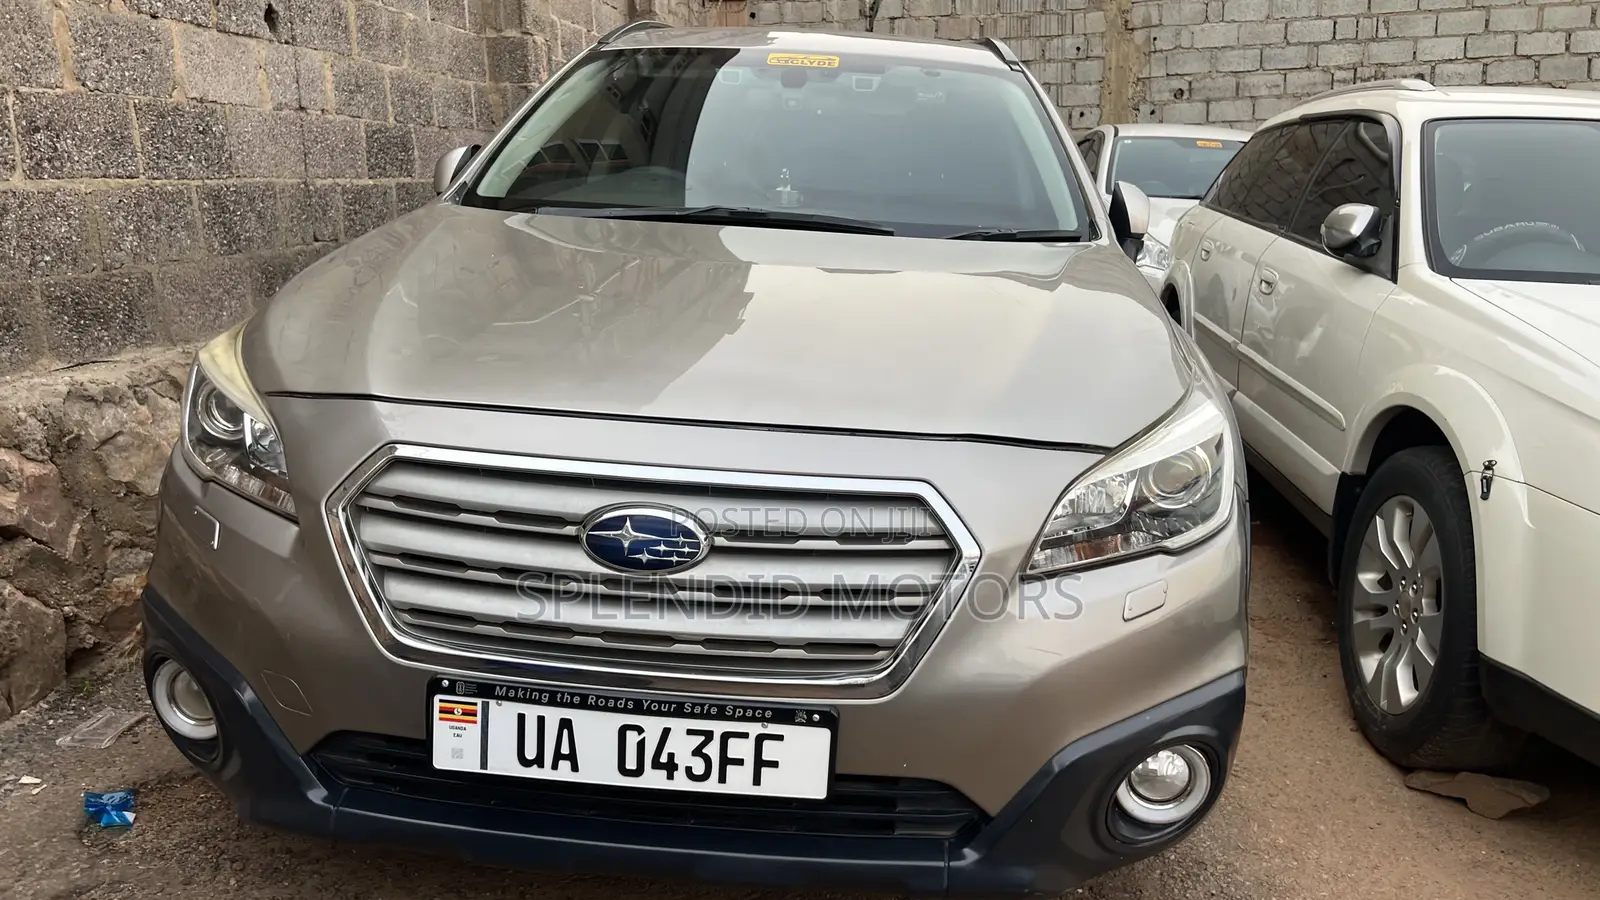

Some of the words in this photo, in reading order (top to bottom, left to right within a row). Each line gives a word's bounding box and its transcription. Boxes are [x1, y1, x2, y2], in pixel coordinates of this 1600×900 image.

[495, 685, 550, 703] Making
[557, 692, 580, 704] the
[587, 695, 634, 709] Roads
[642, 699, 677, 712] Your
[683, 702, 718, 715] Safe
[725, 705, 773, 718] Space
[516, 711, 580, 773] UA
[616, 723, 785, 787] 043FF
